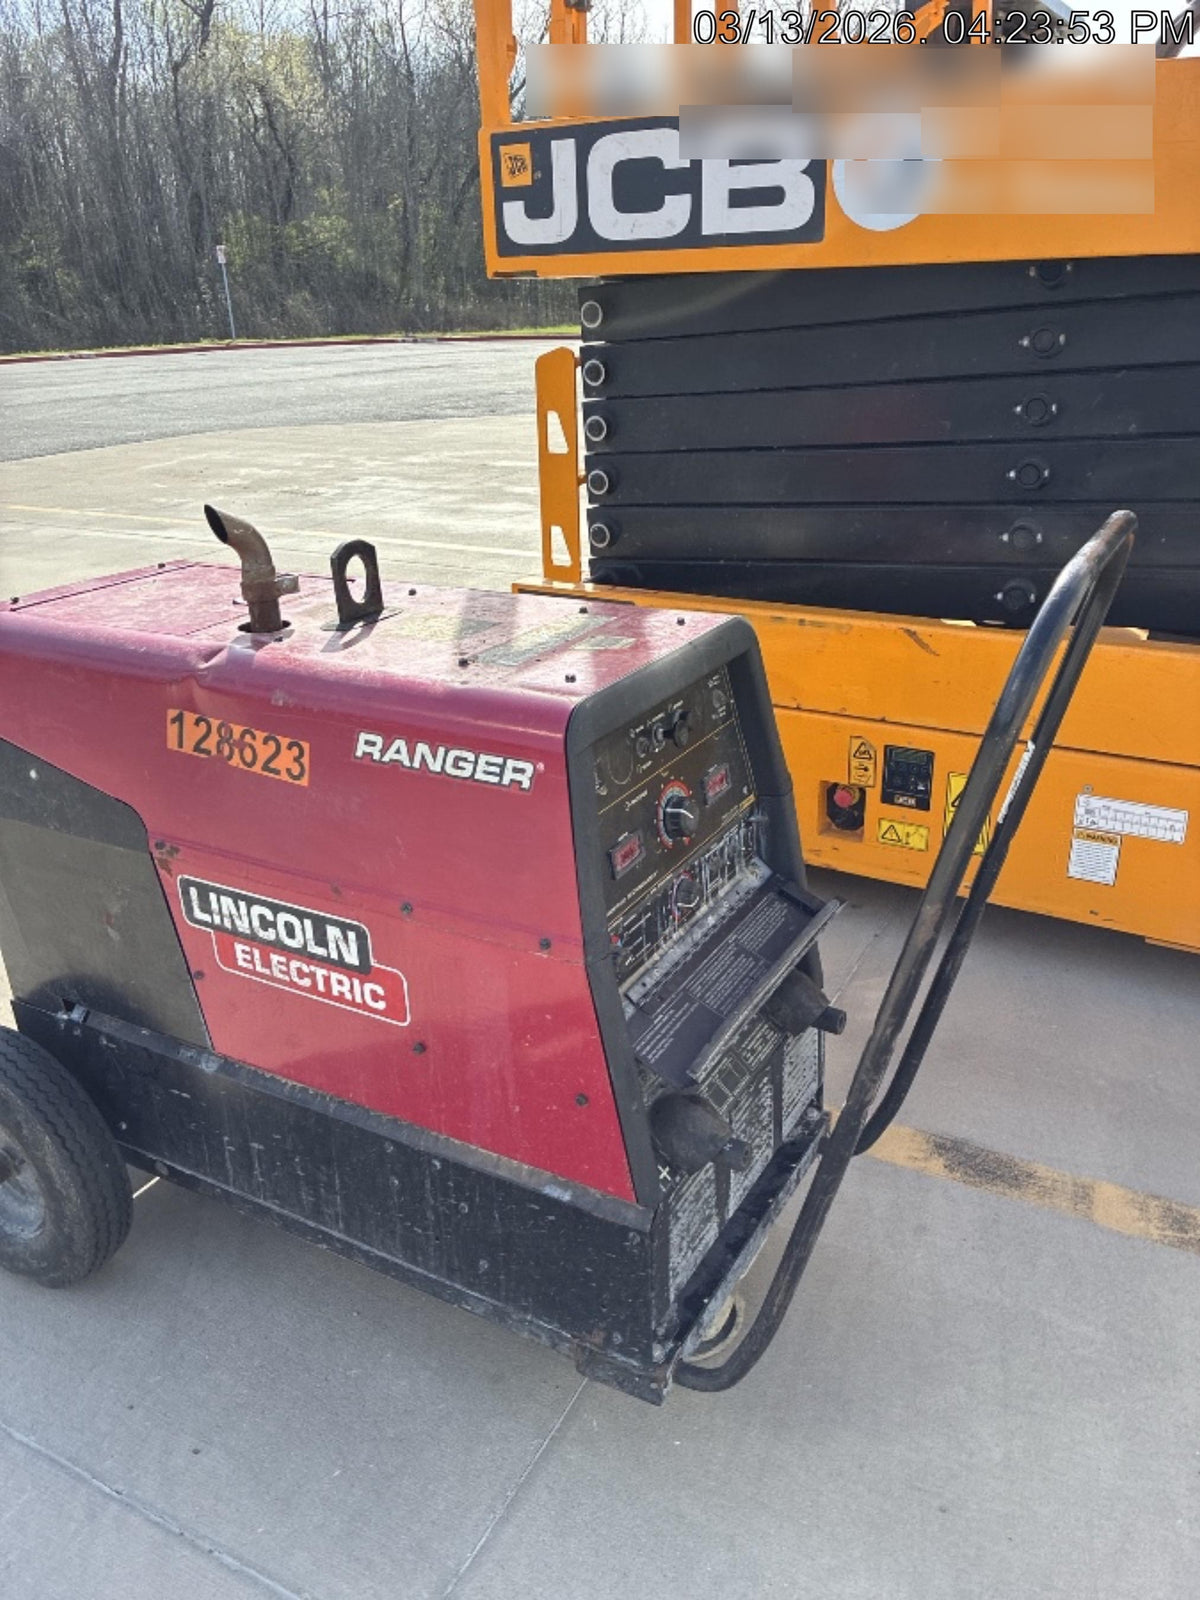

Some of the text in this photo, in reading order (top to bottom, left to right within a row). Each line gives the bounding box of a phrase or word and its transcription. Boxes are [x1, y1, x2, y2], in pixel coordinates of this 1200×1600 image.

[502, 120, 815, 245] JCB
[170, 710, 306, 782] 128623
[355, 731, 535, 790] RANGER
[189, 885, 360, 967] LINCOLN
[233, 941, 387, 1010] ELECTRIC
